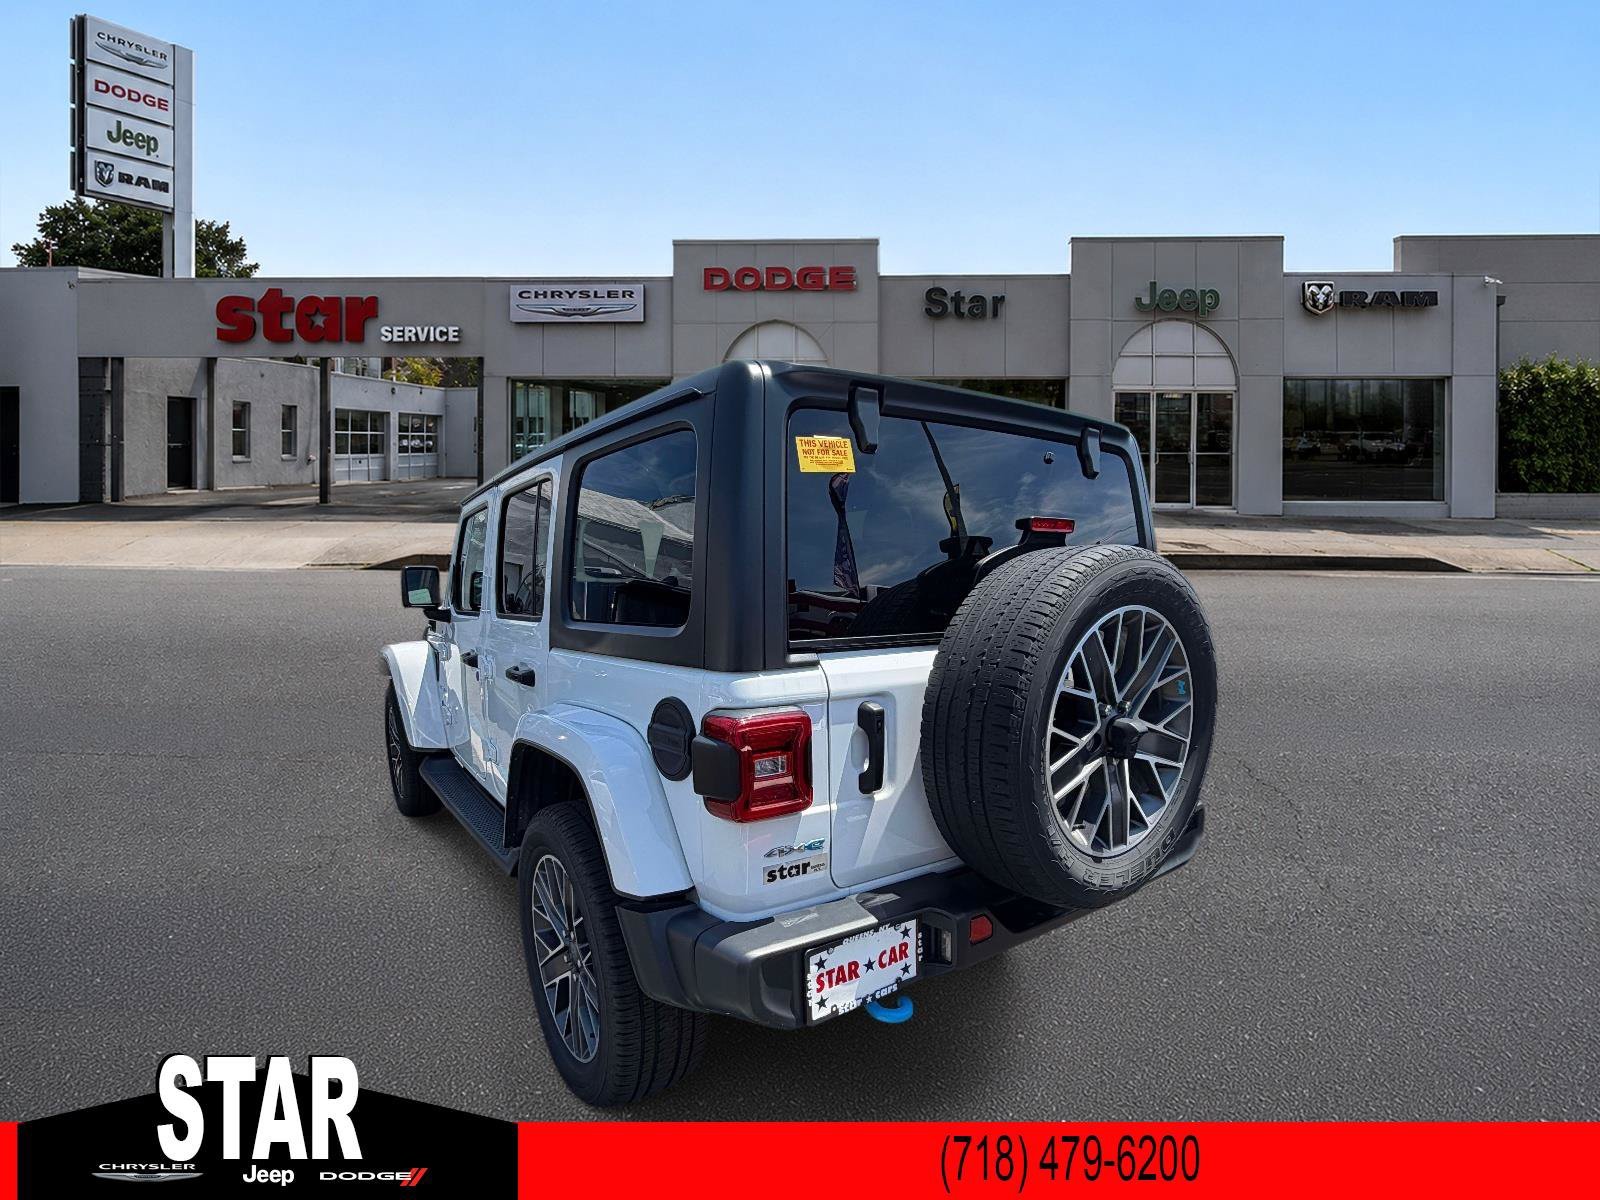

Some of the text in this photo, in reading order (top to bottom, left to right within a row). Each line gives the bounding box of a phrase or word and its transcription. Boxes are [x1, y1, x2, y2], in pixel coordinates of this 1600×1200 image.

[97, 31, 168, 62] CHRYSLER
[94, 79, 169, 112] DODGE
[106, 120, 159, 156] Jeep
[118, 172, 169, 194] RAM
[704, 266, 857, 292] DODGE
[518, 289, 635, 300] CHRYSLER
[924, 286, 1006, 319] Star
[1135, 281, 1220, 317] Jeep
[1339, 291, 1438, 307] RAM
[215, 287, 461, 344] star SERVICE
[800, 439, 848, 448] THIS VEHICLE
[802, 448, 848, 457] NOT FOR SALE
[767, 862, 810, 883] star
[816, 941, 909, 993] STAR CAR
[875, 983, 898, 999] cars
